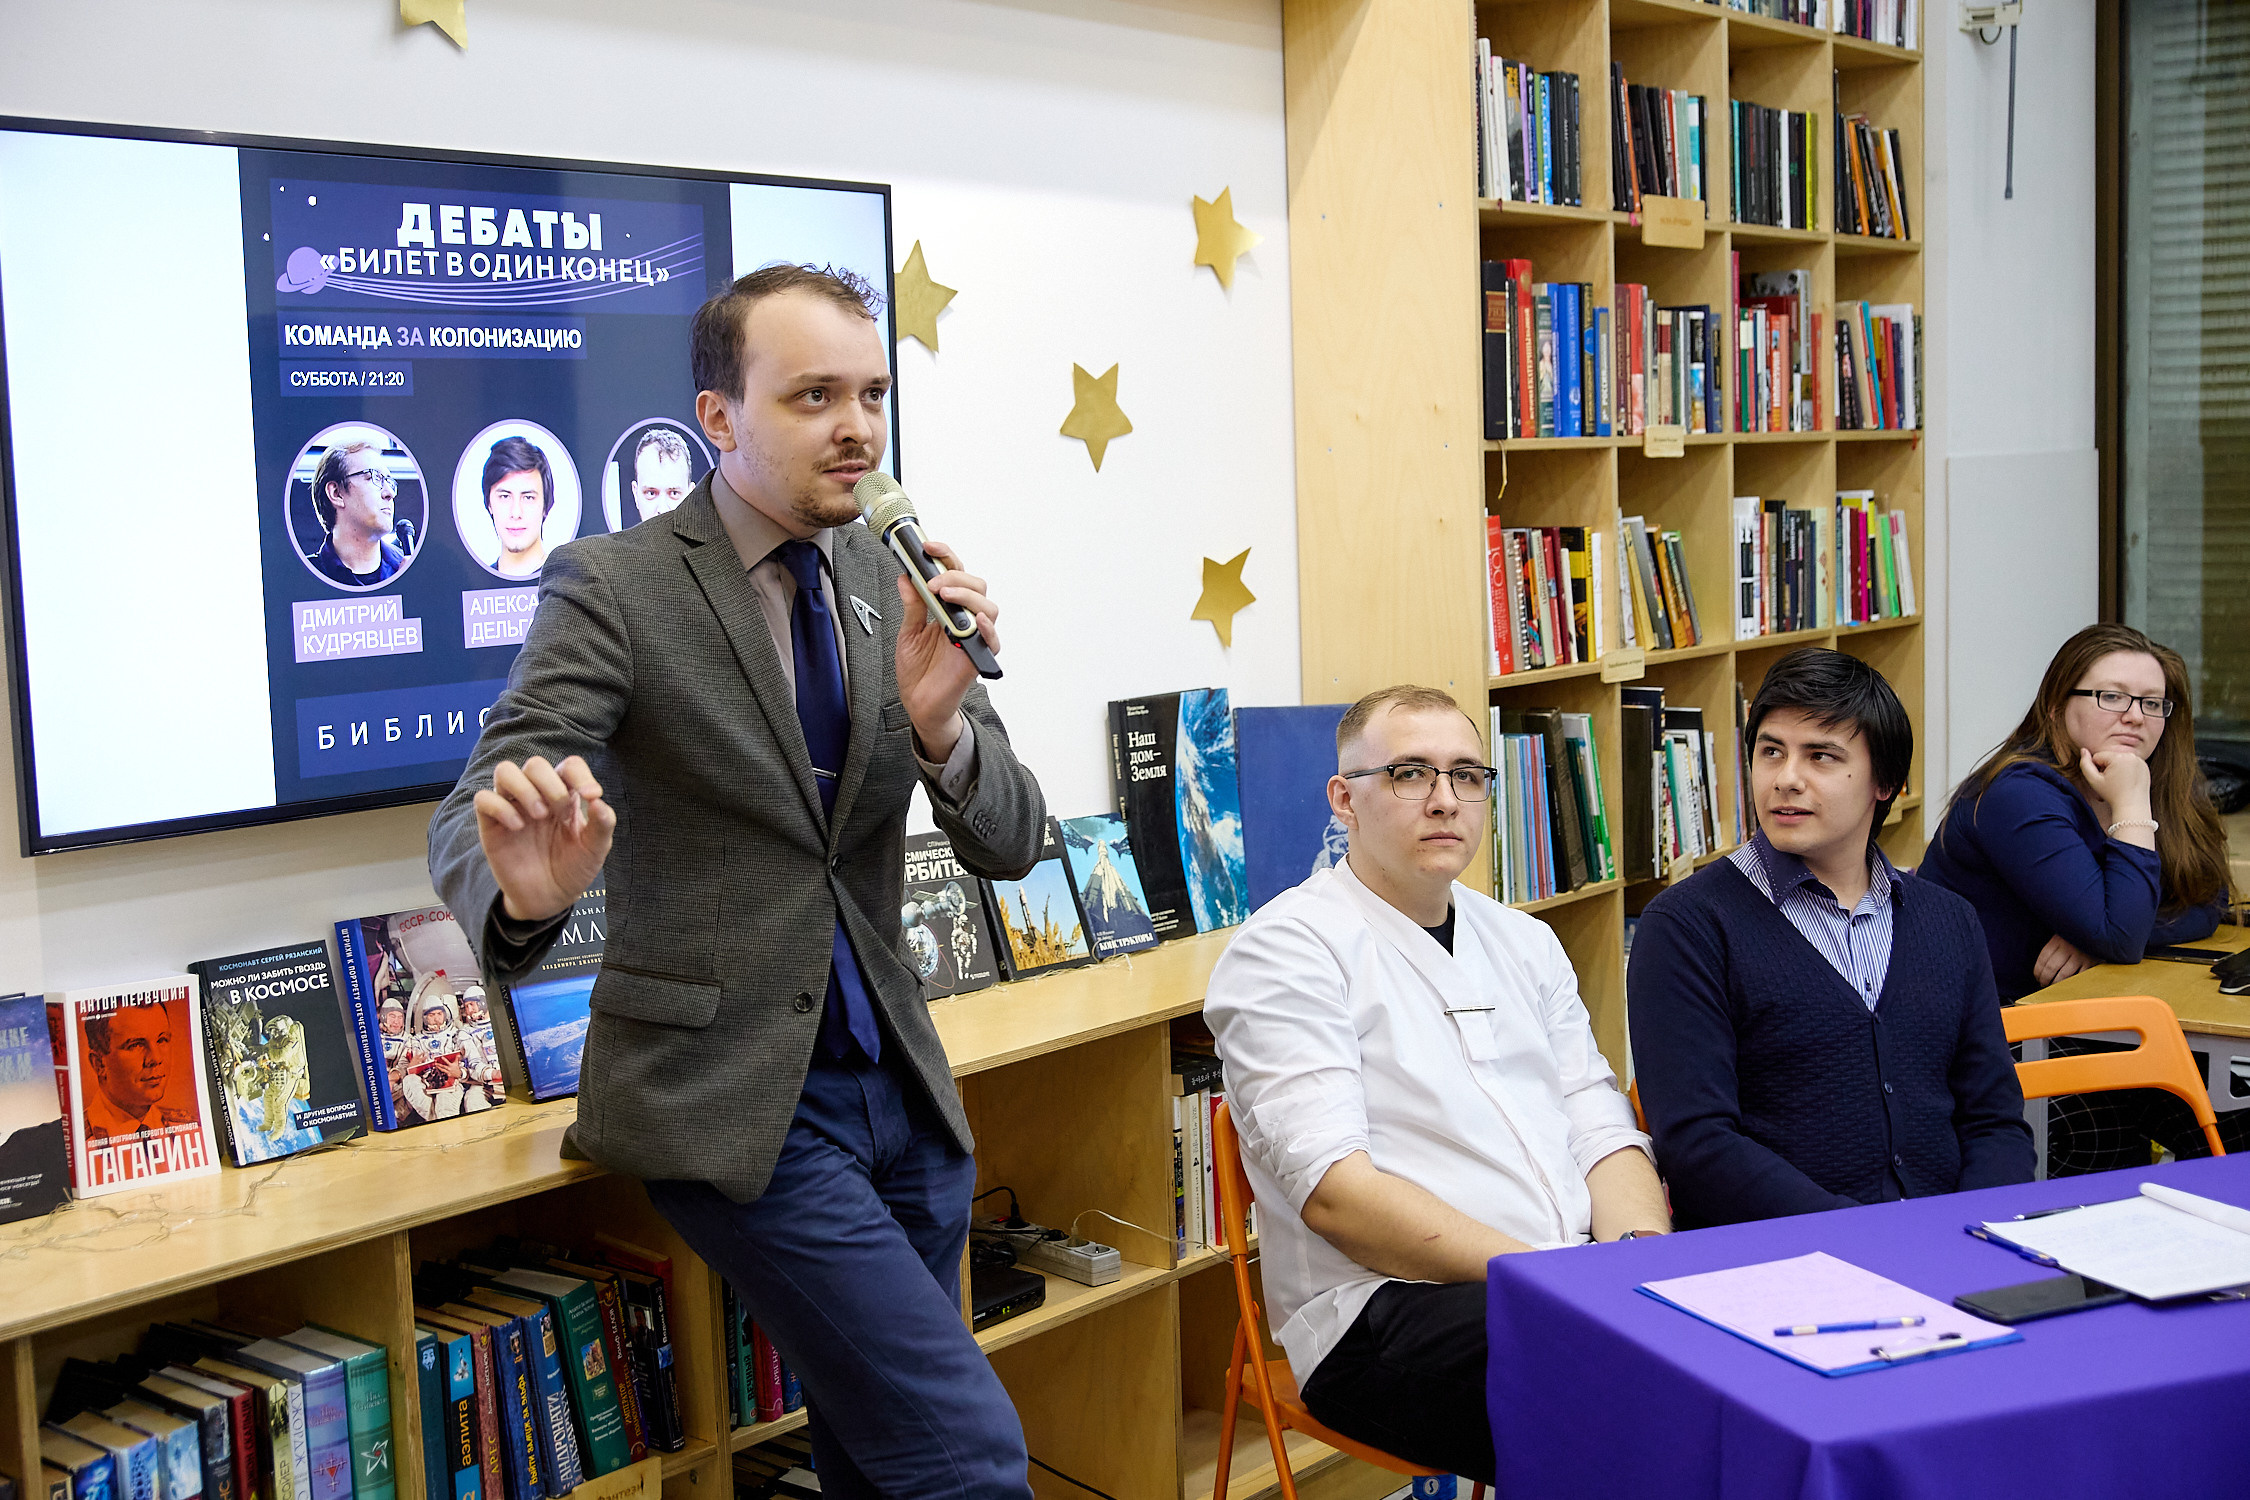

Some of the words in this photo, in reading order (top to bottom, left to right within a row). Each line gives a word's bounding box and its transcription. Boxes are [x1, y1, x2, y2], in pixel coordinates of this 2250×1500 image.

[396, 203, 603, 251] ДЕБАТЫ
[319, 247, 441, 276] «БИЛЕТ
[446, 256, 463, 276] В
[469, 252, 554, 281] ОДИН
[560, 257, 670, 286] КОНЕЦ»
[285, 324, 392, 350] КОМАНДА
[397, 327, 425, 346] ЗА
[429, 326, 582, 351] КОЛОНИЗАЦИЮ
[291, 371, 358, 387] СУББОТА
[360, 371, 366, 387] /
[369, 371, 404, 387] 21:20
[301, 600, 398, 630] ДМИТРИЙ
[303, 628, 418, 657] КУДРЯВЦЕВ
[1127, 731, 1156, 748] Наш
[1131, 765, 1167, 782] Земля
[341, 928, 355, 958] ШТРИХИ
[1099, 932, 1153, 951] КОНСТРУКТОРЫ
[219, 958, 259, 971] КОСМОНАВТ
[260, 952, 284, 964] СЕРГЕЙ
[285, 947, 322, 961] РЯЗАНСКИЙ
[211, 976, 246, 989] МОЖНО
[247, 973, 261, 983] ЛИ
[261, 967, 294, 981] ЗАБИТЬ
[294, 961, 326, 974] ГВОЗДЬ
[229, 990, 242, 1004] В
[244, 973, 330, 1002] КОСМОСЕ
[348, 966, 361, 1001] ПОРТРЕТУ
[79, 995, 118, 1014] АНТОН
[121, 986, 186, 1009] ПЕРВУШИН
[354, 1002, 373, 1064] ОТЕЧЕСТВЕННОЙ
[367, 1065, 383, 1126] КОСМОНАВТИКИ
[303, 1108, 326, 1119] ДРУГИЕ
[326, 1103, 356, 1115] ВОПРОСЫ
[309, 1110, 357, 1126] КОСМОНАВТИКЕ
[223, 1111, 235, 1146] КОСМОСЕ
[88, 1133, 208, 1187] ГАГАРИН
[521, 1406, 530, 1419] ЗА
[618, 1383, 632, 1424] ИМПЕРАТОР
[290, 1389, 307, 1467] ДЖОРДЖ
[523, 1419, 534, 1454] ЗАМУЖ
[548, 1391, 573, 1483] АНДРОНАТИ
[488, 1435, 500, 1474] АРЕС
[528, 1453, 538, 1486] ВЫЙТИ
